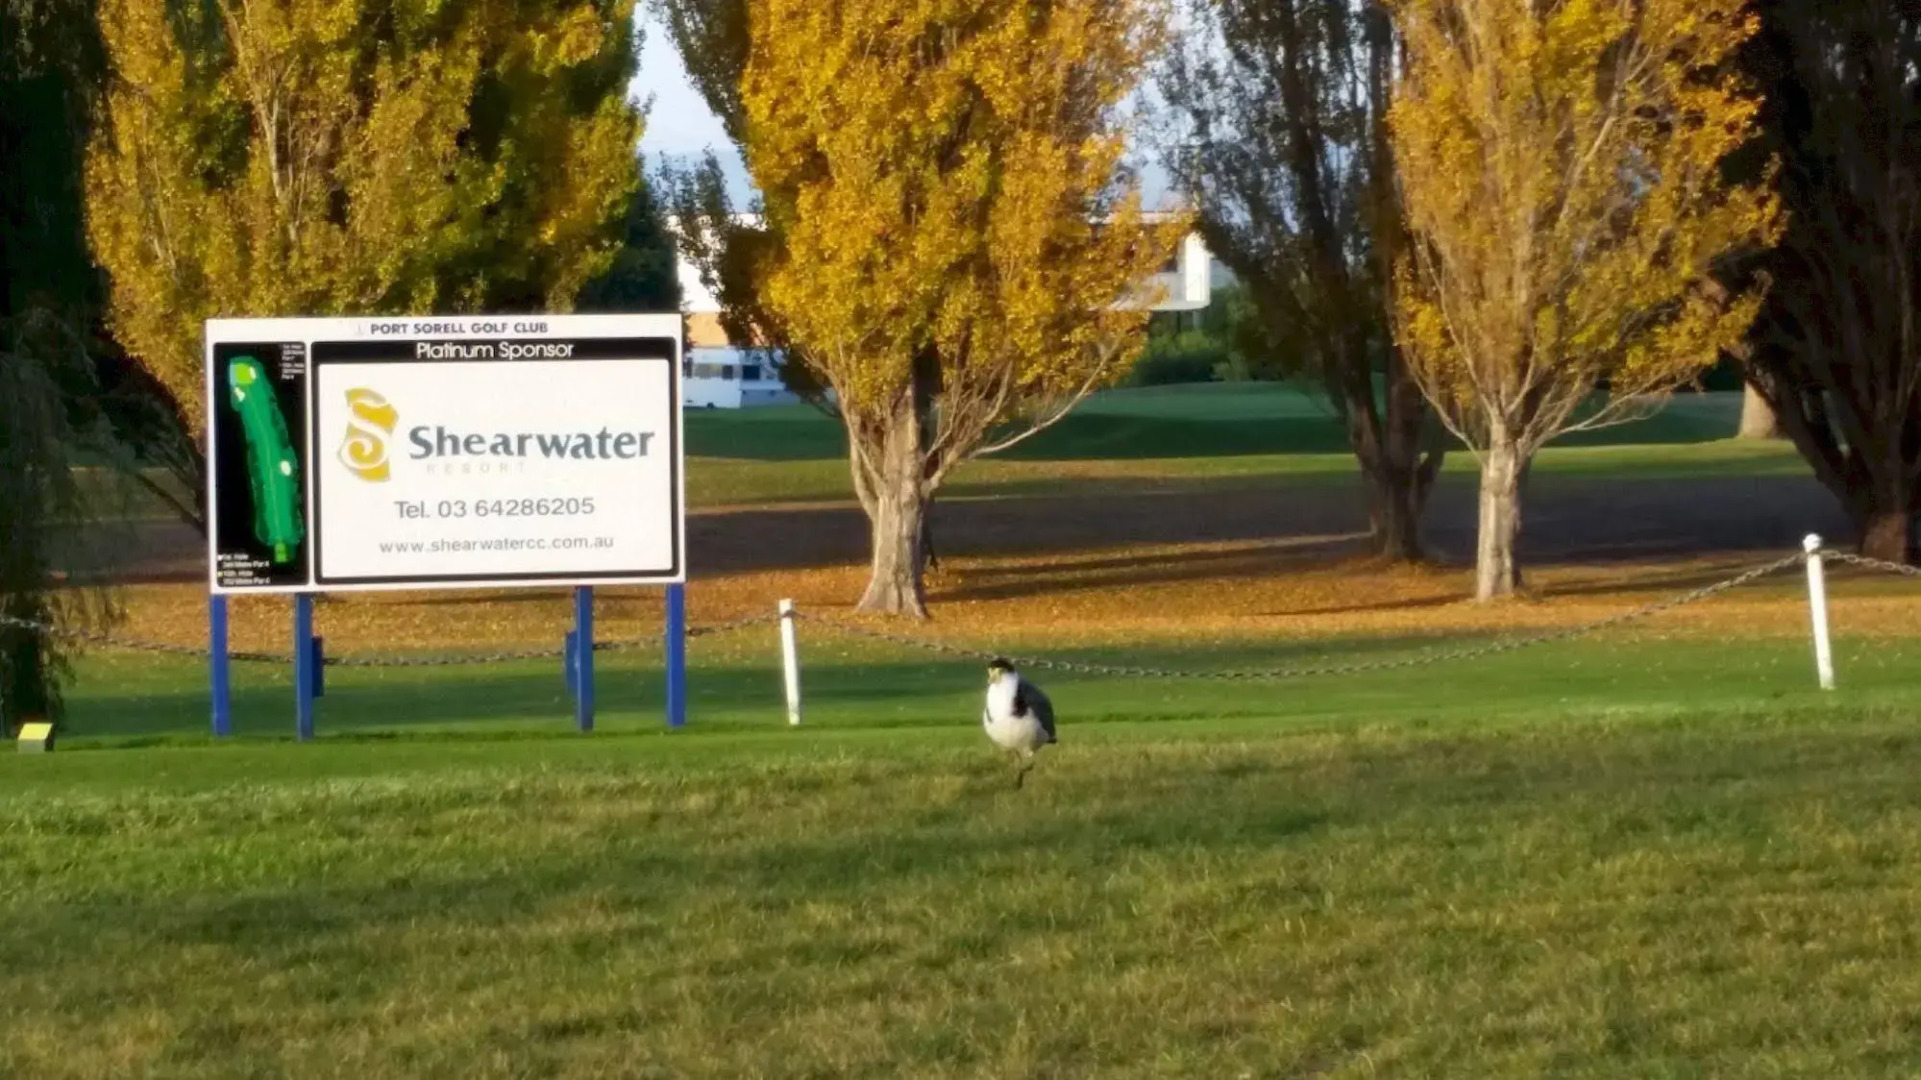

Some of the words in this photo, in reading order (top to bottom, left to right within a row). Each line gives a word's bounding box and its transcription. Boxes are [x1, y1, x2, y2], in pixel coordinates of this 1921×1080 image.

[370, 324, 408, 334] PORT
[413, 322, 466, 334] SORELL
[471, 322, 508, 333] GOLF
[514, 322, 548, 333] CLUB
[416, 342, 494, 359] Platinum
[498, 341, 574, 360] Sponsor
[408, 426, 655, 460] Shearwater
[426, 463, 526, 474] RESORT
[394, 501, 430, 519] Tel.
[438, 501, 467, 518] 03
[475, 498, 595, 517] 64286205
[379, 536, 614, 553] www.shearwatercc.com.au
